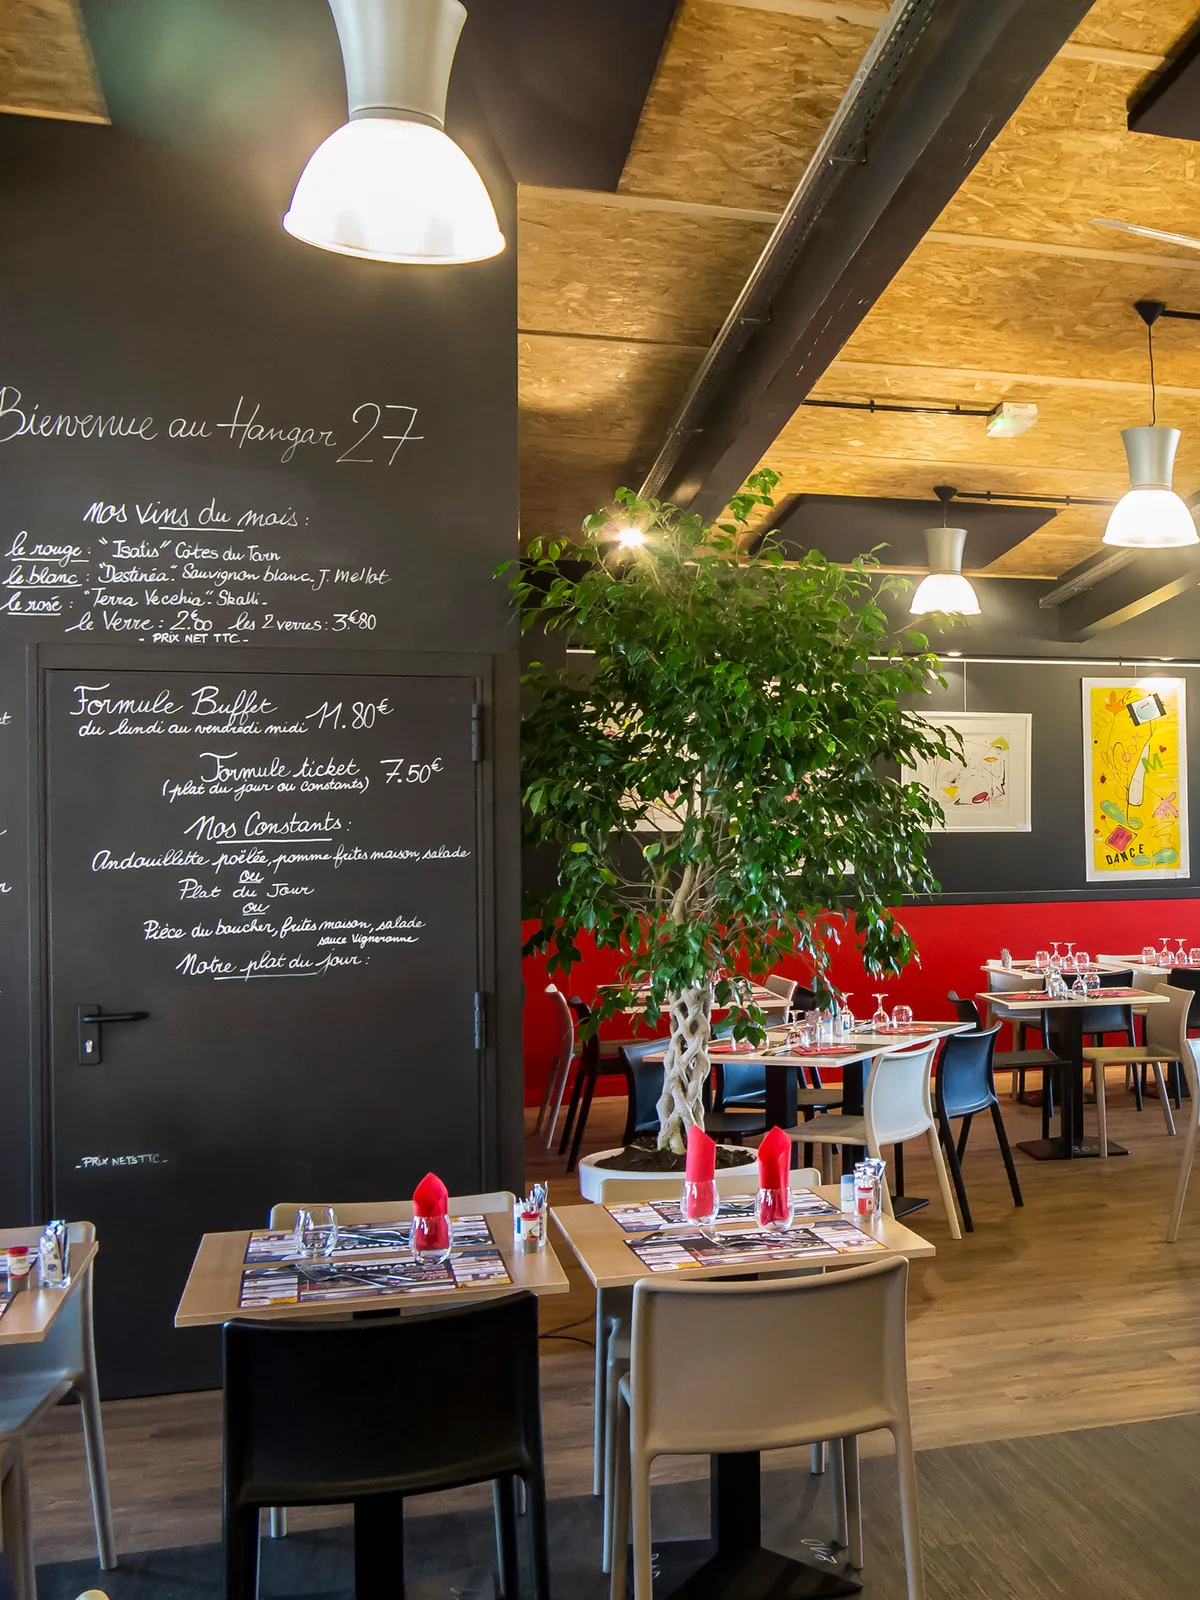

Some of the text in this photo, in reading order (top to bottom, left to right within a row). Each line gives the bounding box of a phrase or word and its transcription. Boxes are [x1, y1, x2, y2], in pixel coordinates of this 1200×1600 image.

[0, 386, 424, 466] Bienvenue au Hangar 27
[198, 498, 231, 525] du
[4, 531, 26, 557] le
[175, 541, 219, 559] Côtes
[222, 545, 246, 561] du
[246, 545, 282, 562] Tarn
[2, 565, 25, 585] le
[182, 563, 261, 587] Sauvignon
[0, 591, 22, 612] le
[64, 611, 95, 632] le
[228, 611, 256, 631] les
[261, 613, 275, 630] 2
[184, 633, 209, 644] NET
[213, 633, 241, 643] TTC
[69, 683, 184, 716] Formule
[191, 685, 278, 726] Buffet
[78, 718, 309, 737] du lundi au vendredi midi
[199, 751, 292, 783] Formule
[292, 757, 361, 778] ticket
[208, 783, 234, 795] du
[233, 779, 275, 802] jour
[276, 782, 297, 792] ou
[183, 814, 237, 841] Nos
[271, 854, 333, 874] pomme
[332, 843, 369, 869] frites
[421, 844, 471, 860] salade
[1105, 844, 1144, 865] DANCE
[238, 869, 264, 882] ou
[178, 878, 315, 900] Plat du Jour
[242, 902, 270, 913] ou
[143, 919, 188, 940] Pièce
[191, 922, 213, 938] du
[279, 915, 318, 939] frites
[374, 914, 427, 932] salade
[316, 935, 348, 947] sauce
[175, 953, 238, 976] Notre
[239, 950, 287, 982] plat
[288, 952, 314, 969] du
[111, 1155, 138, 1166] NETS
